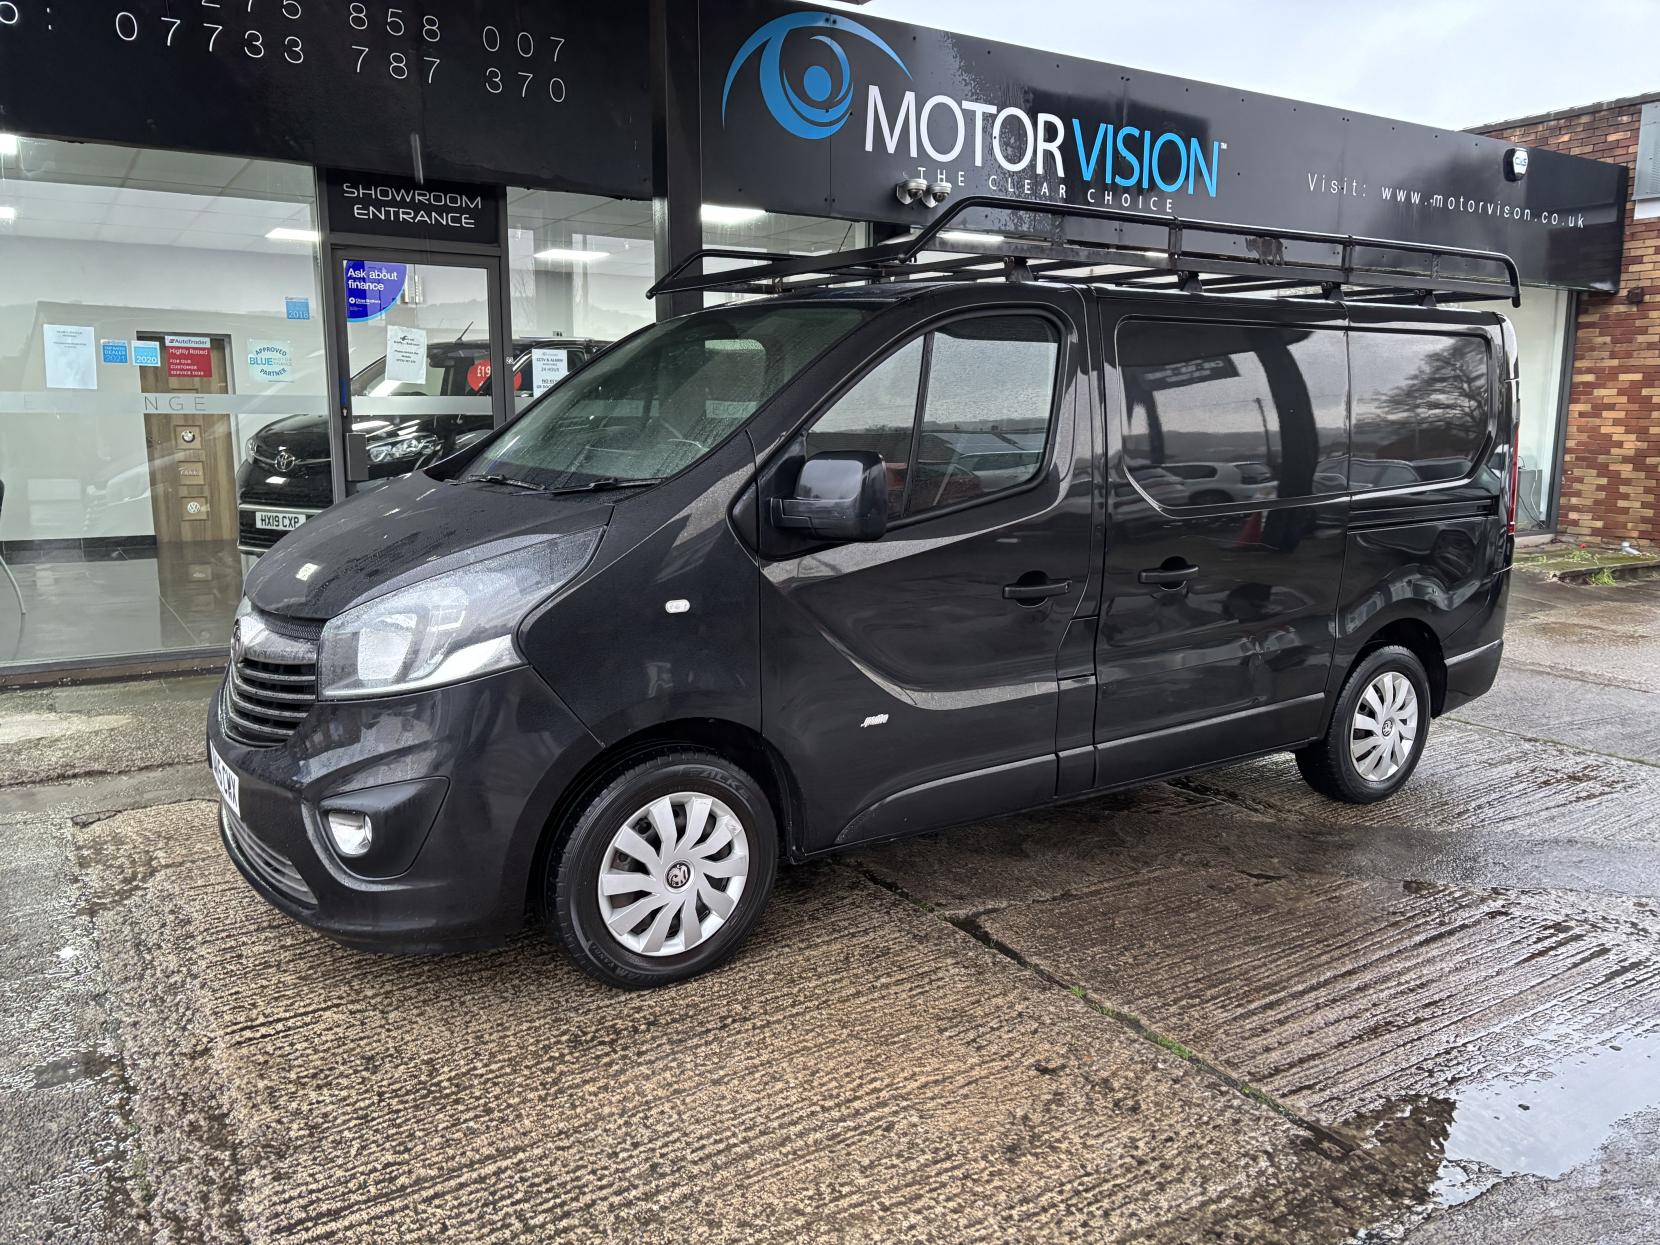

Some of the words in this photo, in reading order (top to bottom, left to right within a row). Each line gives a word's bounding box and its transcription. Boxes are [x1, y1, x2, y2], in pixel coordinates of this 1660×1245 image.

[350, 2, 441, 42] 858
[482, 25, 566, 63] 007
[115, 11, 304, 64] 07733
[351, 45, 441, 84] 787
[485, 67, 566, 103] 370
[343, 183, 482, 209] SHOWROOM
[917, 167, 965, 186] THE
[988, 175, 1067, 199] CLEAR
[1087, 188, 1173, 213] CHOICE
[1307, 172, 1366, 198] Visit:
[1381, 185, 1585, 229] www.motorvison.co.uk
[353, 204, 476, 228] ENTRANCE
[347, 268, 367, 278] Ask
[369, 269, 398, 281] about
[347, 279, 385, 291] finance
[249, 356, 273, 366] BLUE
[255, 346, 288, 357] APPROVED
[259, 367, 288, 377] PARTNER
[260, 513, 280, 528] HX19
[281, 515, 300, 529] CXP
